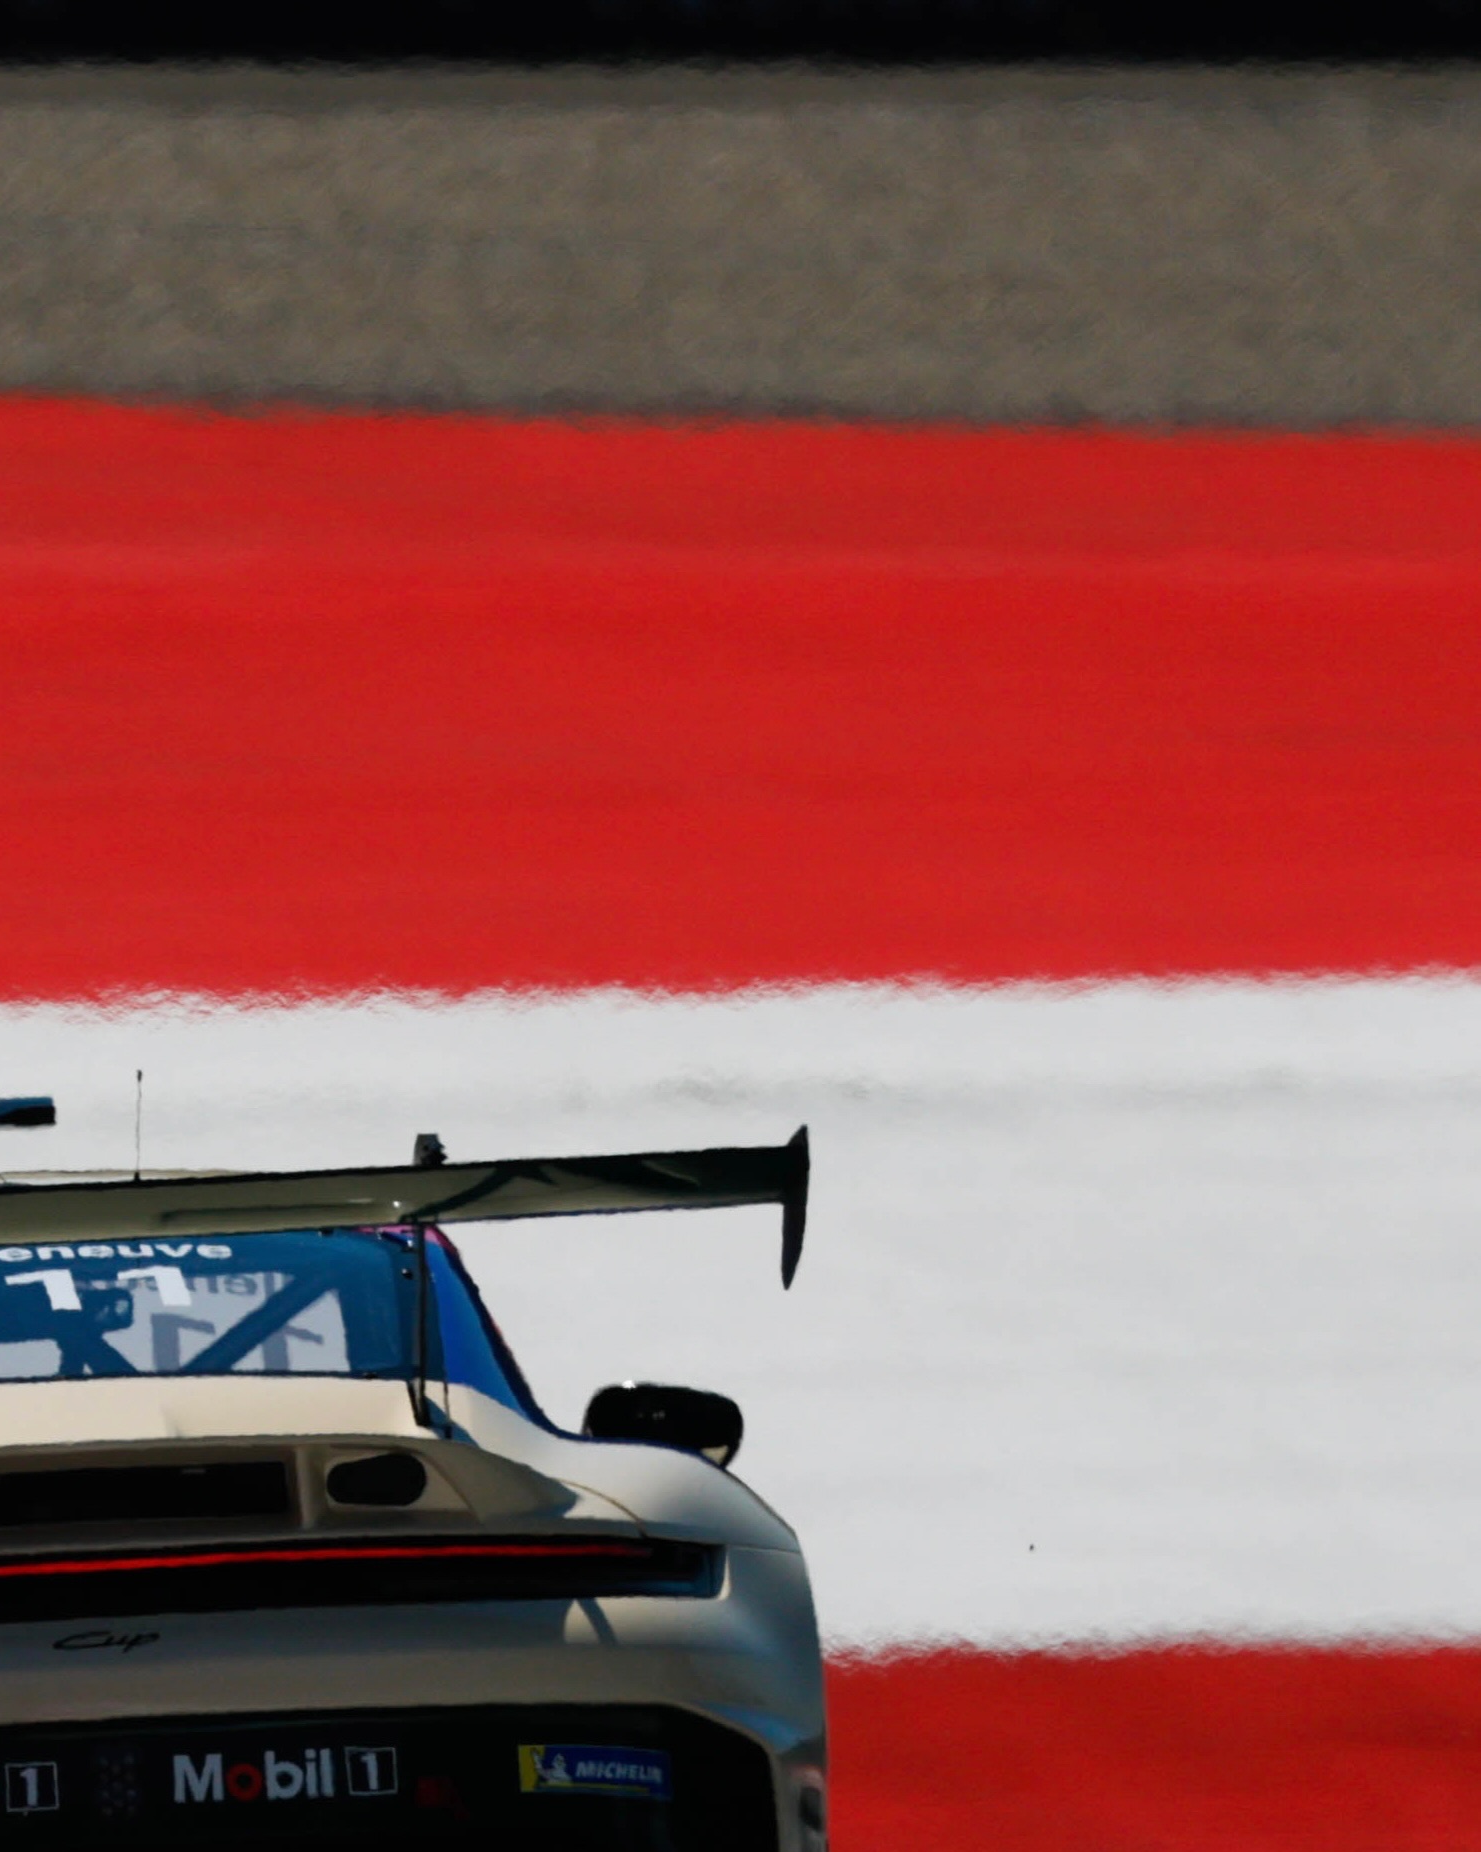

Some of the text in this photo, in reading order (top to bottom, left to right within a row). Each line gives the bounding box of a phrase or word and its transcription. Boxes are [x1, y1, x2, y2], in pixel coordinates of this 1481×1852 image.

[52, 1630, 161, 1653] Cup
[173, 1747, 335, 1803] Mobil
[574, 1760, 663, 1784] MICHELIN
